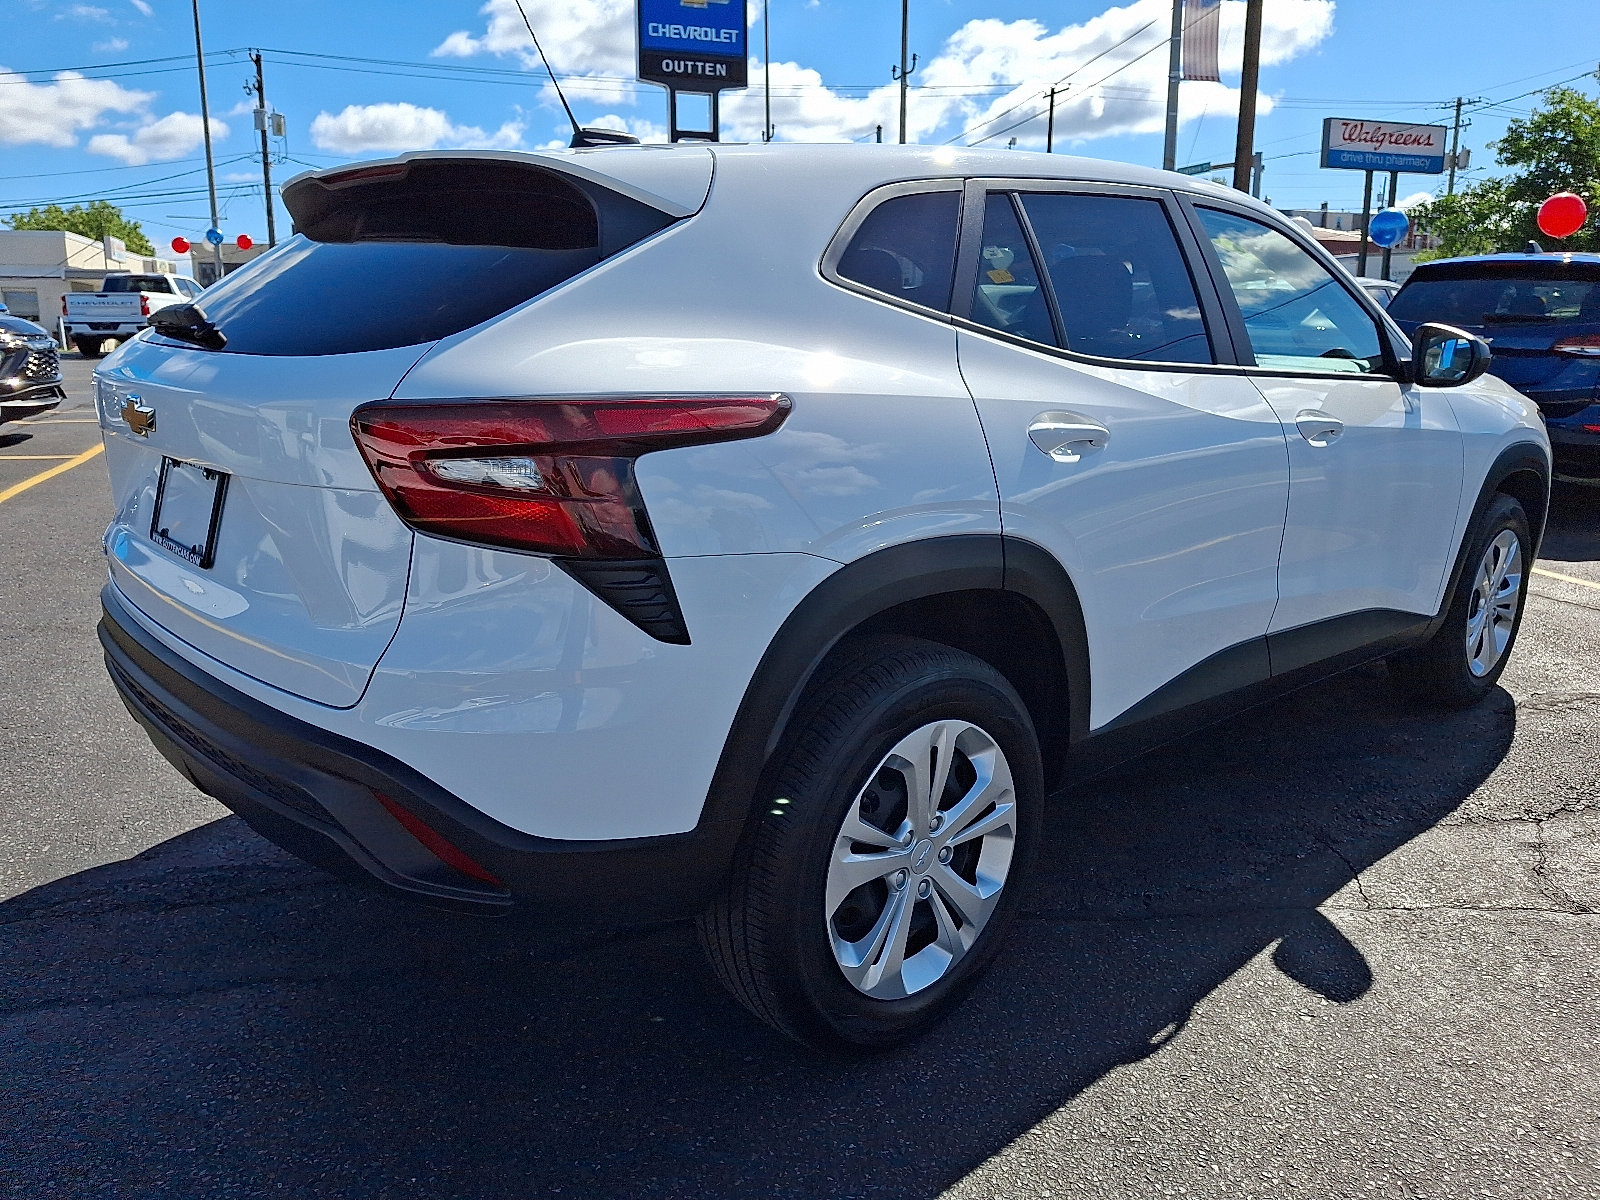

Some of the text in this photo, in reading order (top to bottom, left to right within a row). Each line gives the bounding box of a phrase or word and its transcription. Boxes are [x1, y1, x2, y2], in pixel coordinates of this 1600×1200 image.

[648, 23, 739, 43] CHEVROLET
[661, 59, 727, 77] OUTTEN
[1341, 122, 1434, 151] Walgreens
[1341, 152, 1431, 169] drive thru pharmacy
